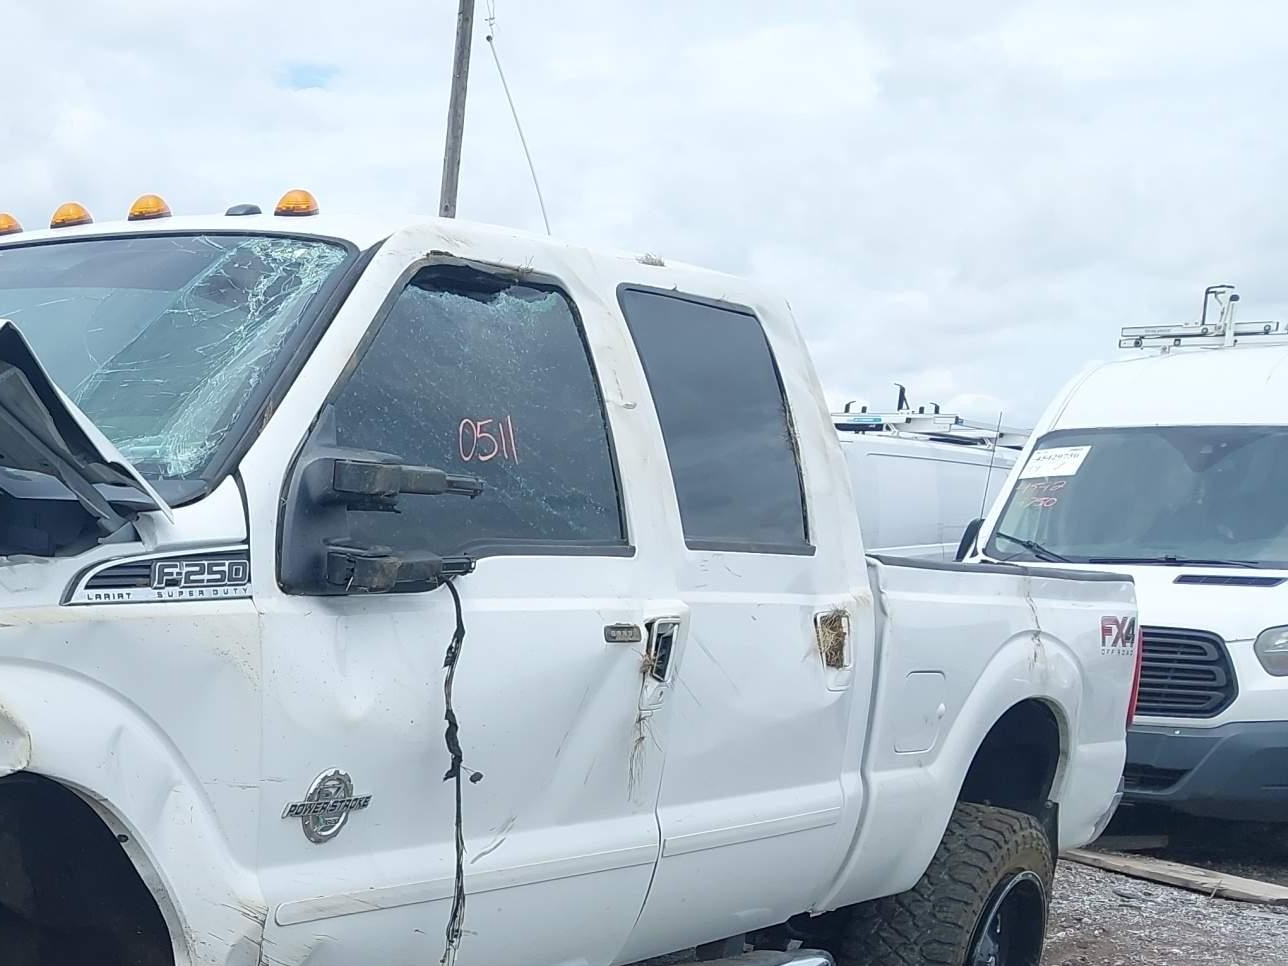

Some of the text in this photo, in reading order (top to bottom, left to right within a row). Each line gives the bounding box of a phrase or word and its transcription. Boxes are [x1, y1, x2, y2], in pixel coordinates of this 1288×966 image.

[459, 415, 519, 465] 0511
[153, 560, 249, 588] F-250
[87, 592, 131, 600] LARIAT
[157, 588, 248, 598] SUPER DUTY
[1101, 616, 1136, 647] FX4
[287, 795, 371, 816] POWER STROKE
